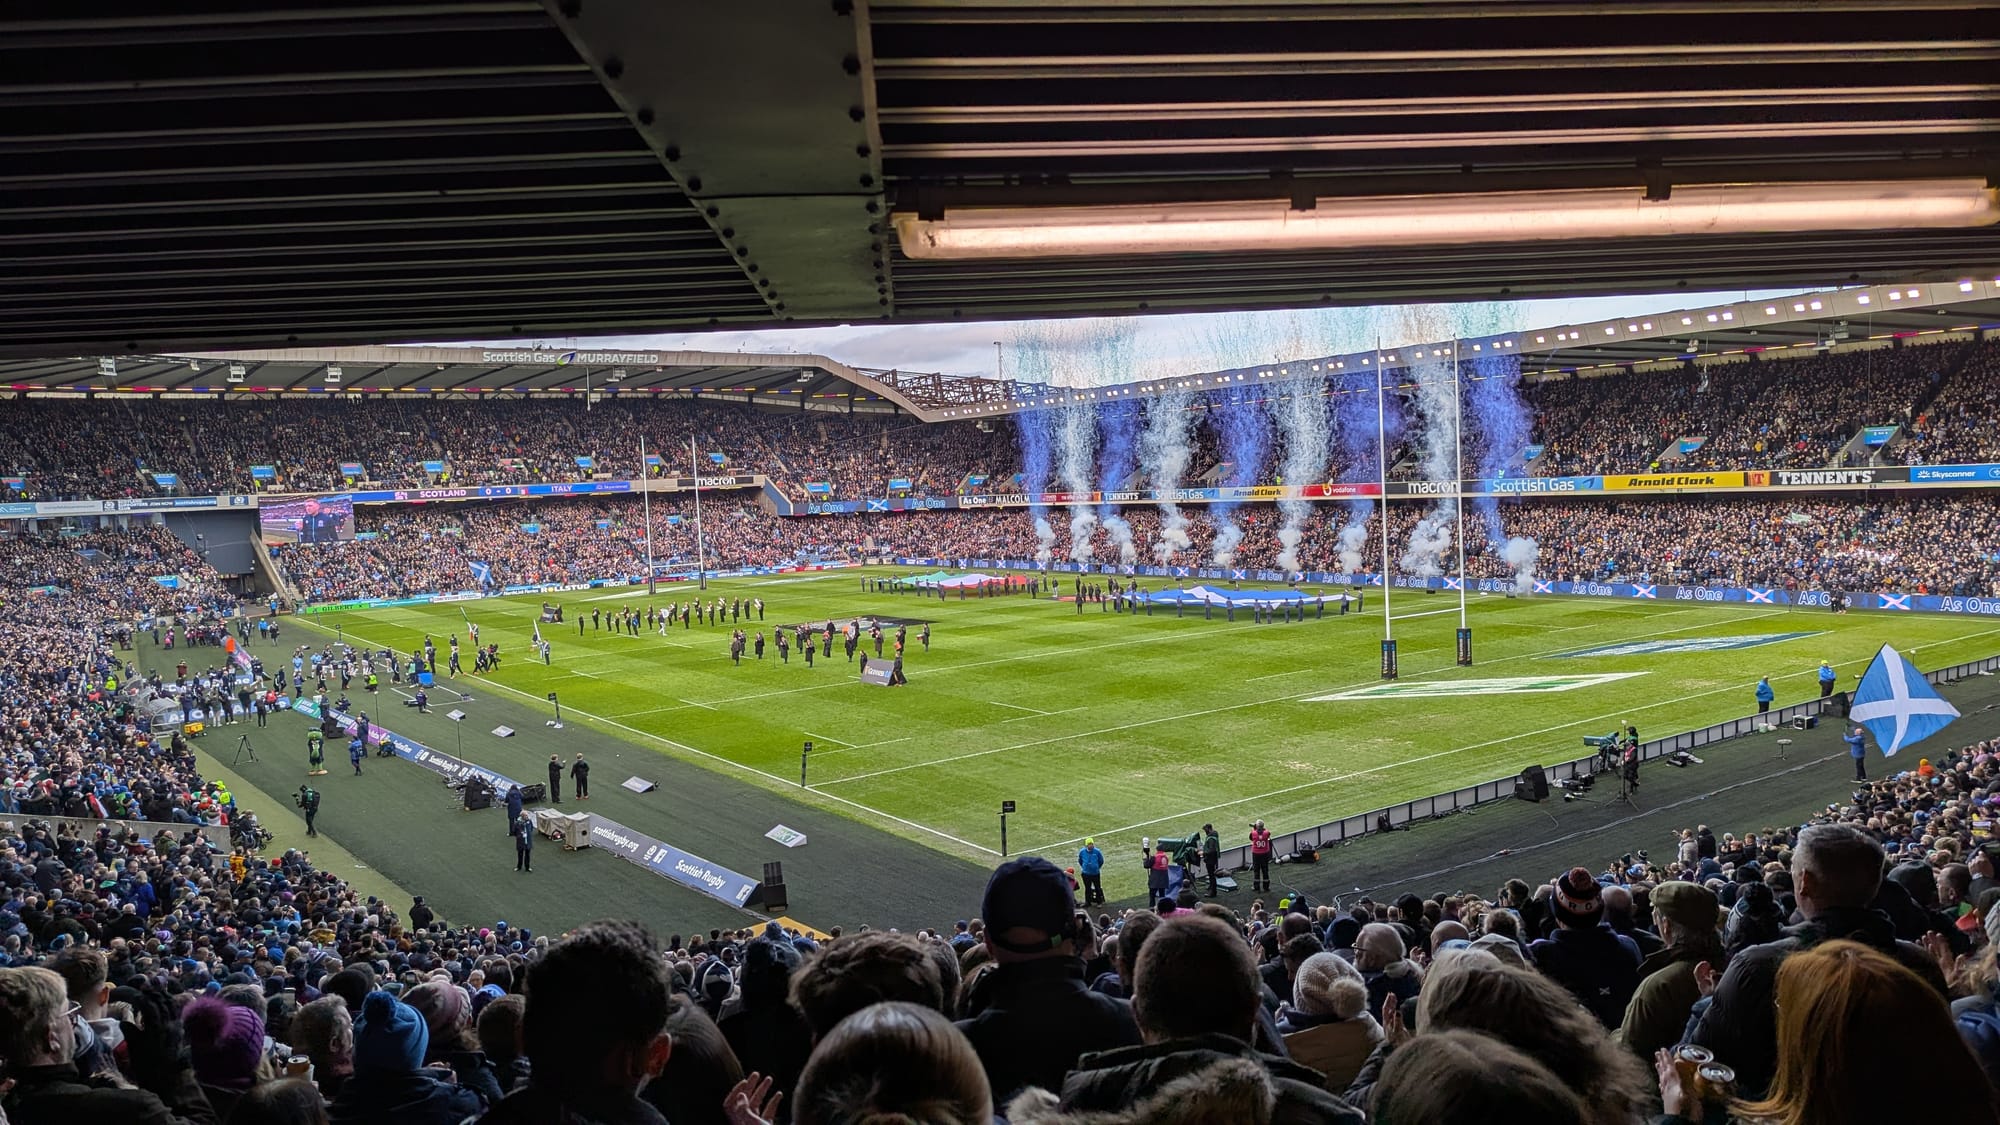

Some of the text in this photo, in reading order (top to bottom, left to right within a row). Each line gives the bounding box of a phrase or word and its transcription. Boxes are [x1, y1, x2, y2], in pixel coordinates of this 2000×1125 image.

[483, 352, 658, 364] Scottish Gas MURRAYFIELD
[697, 476, 736, 486] macron
[1628, 476, 1715, 487] Arnold Clark
[1932, 471, 1976, 479] Skyscanner
[420, 489, 467, 498] SCOTLAND
[551, 484, 572, 493] ITALY
[1408, 481, 1459, 494] macron
[1493, 478, 1575, 492] Scottish Gas
[995, 494, 1030, 504] MALCOLM
[1188, 488, 1204, 500] Gas
[1234, 488, 1282, 497] Arnold Clark
[808, 502, 844, 513] As One
[912, 498, 945, 509] As One
[1478, 579, 1515, 592] As One
[1572, 582, 1612, 596] As One
[1676, 586, 1723, 601] As One
[1798, 591, 1816, 606] As
[1940, 596, 1962, 613] As
[592, 826, 640, 852] scottishrugby.org
[675, 859, 726, 889] Scottish Rugby
